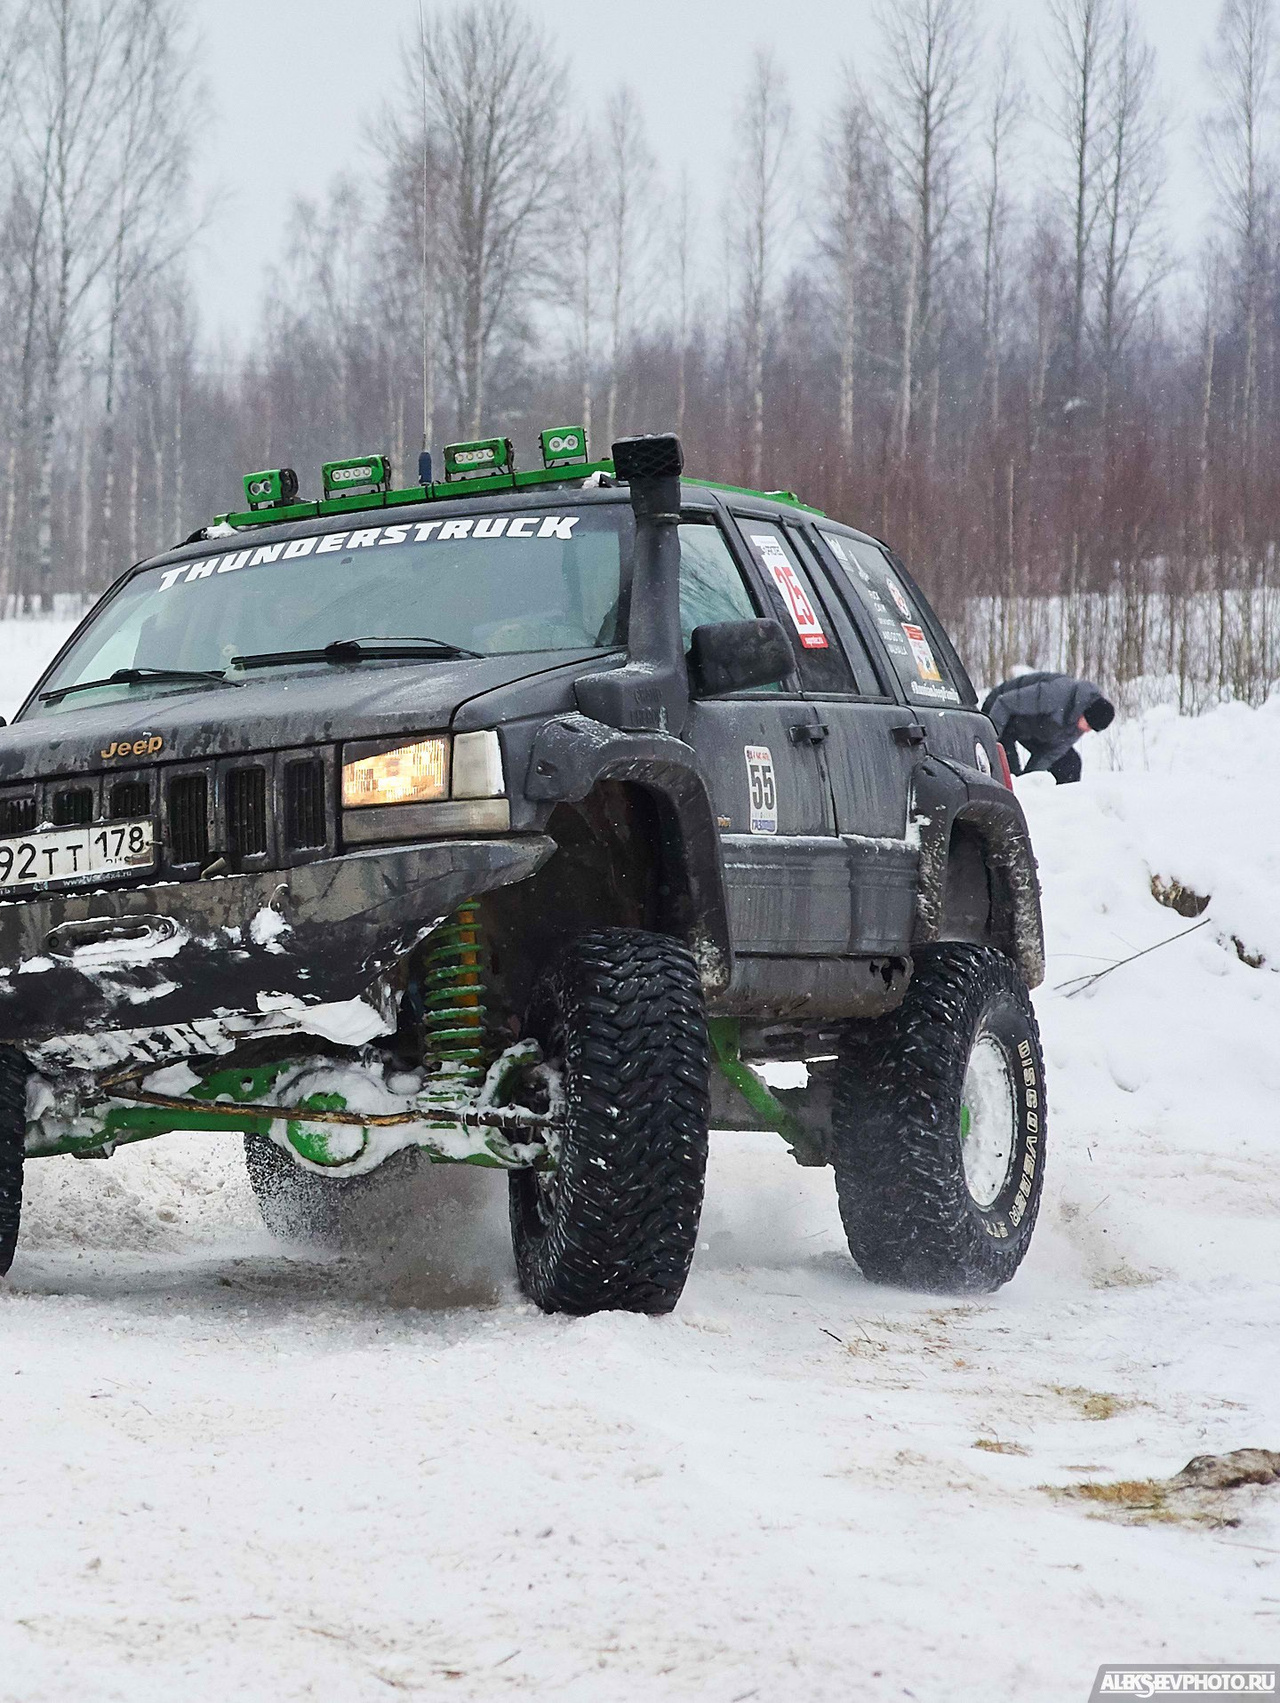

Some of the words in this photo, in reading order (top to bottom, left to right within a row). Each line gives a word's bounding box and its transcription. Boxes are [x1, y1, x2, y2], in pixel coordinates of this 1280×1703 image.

[157, 516, 580, 593] THUNDERSTRUCK
[773, 566, 815, 626] 25
[101, 736, 163, 759] Jeep
[750, 765, 775, 810] 55
[94, 826, 144, 858] 178
[1009, 1039, 1038, 1228] DISCOVERER
